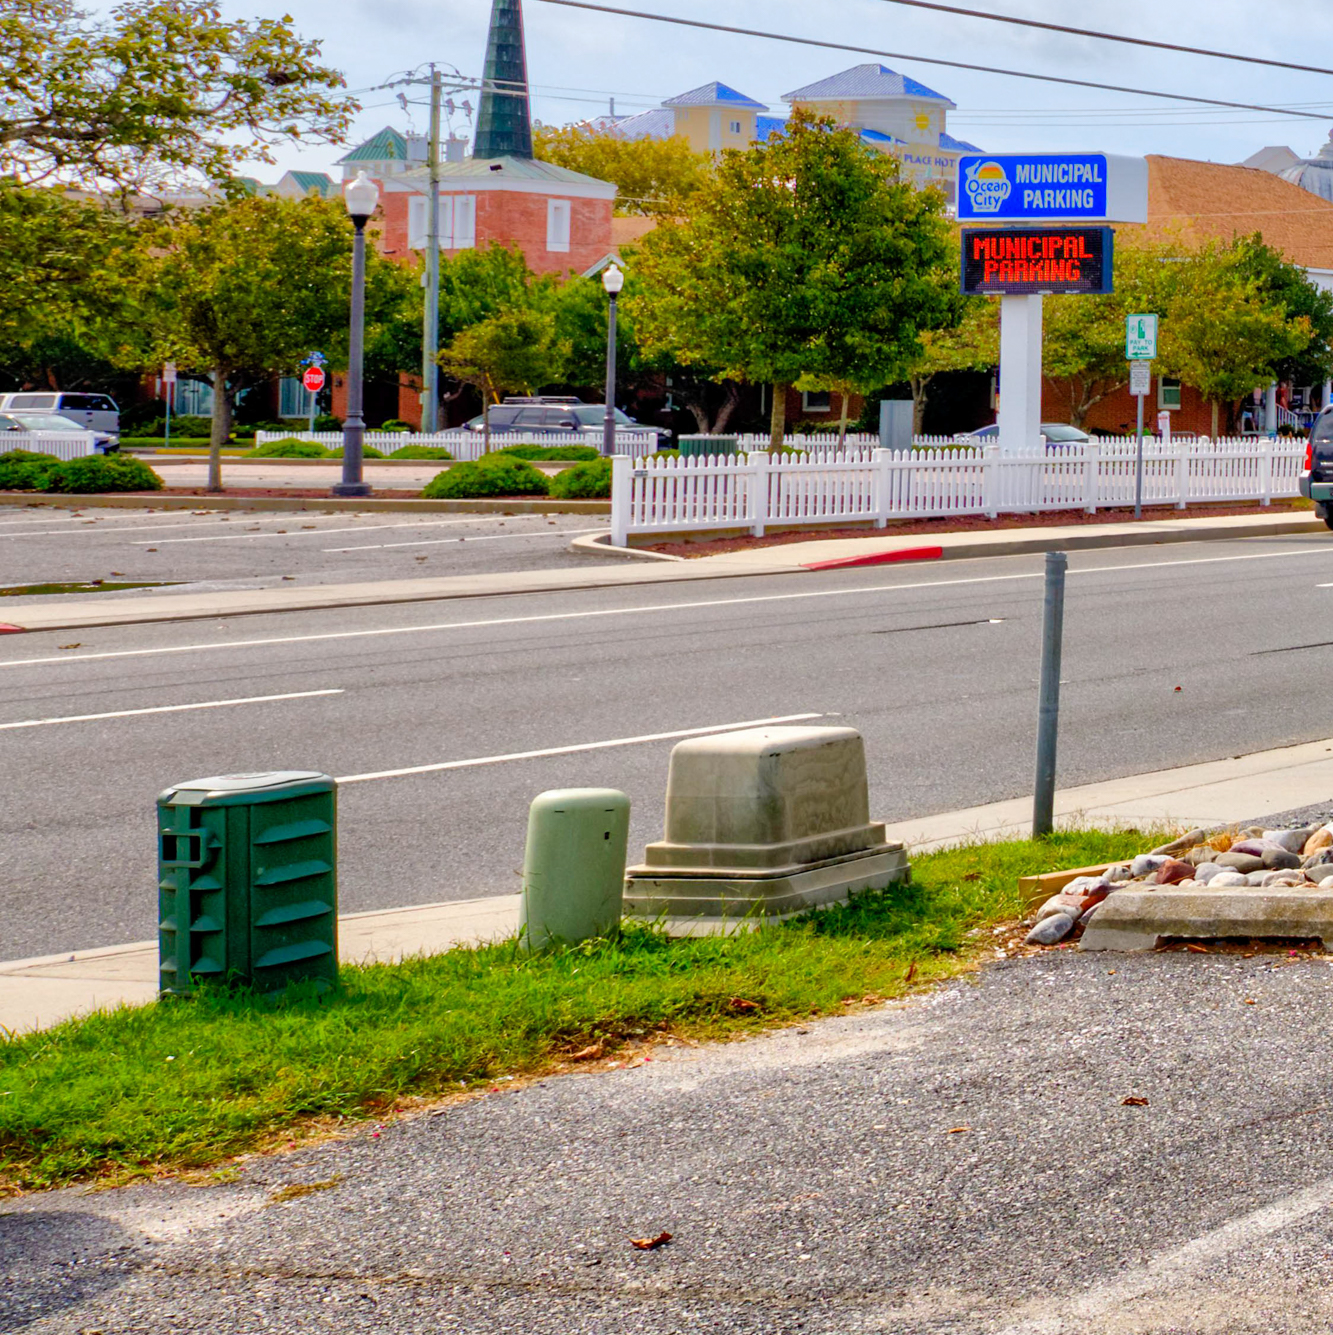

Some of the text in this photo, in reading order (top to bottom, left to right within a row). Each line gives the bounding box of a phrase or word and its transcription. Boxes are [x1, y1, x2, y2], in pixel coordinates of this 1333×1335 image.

[904, 153, 956, 168] PLACE HOT
[1015, 163, 1103, 184] MUNICIPAL
[968, 179, 1009, 196] Ocean
[974, 192, 1001, 210] City
[1023, 189, 1094, 209] PARKING
[973, 236, 1094, 260] MUNICIPAL
[983, 259, 1081, 283] PARKING
[305, 374, 323, 384] STOP
